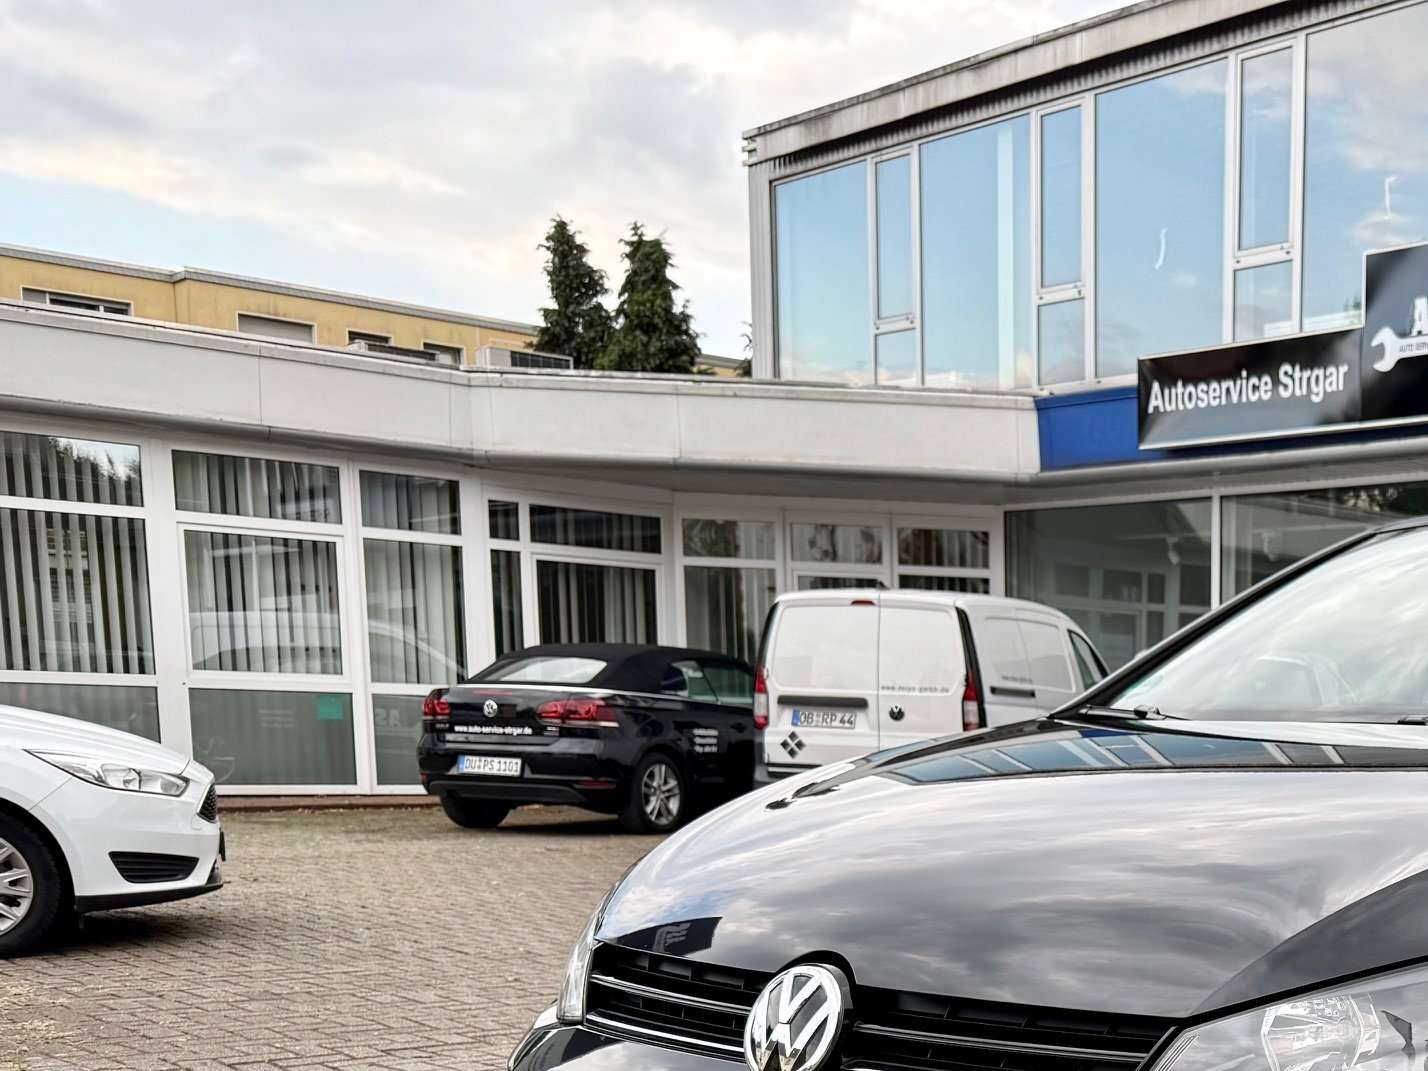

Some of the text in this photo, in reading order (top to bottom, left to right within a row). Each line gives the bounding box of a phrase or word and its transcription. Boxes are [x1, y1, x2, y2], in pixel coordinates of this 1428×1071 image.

[1147, 361, 1349, 415] Autoservice Strgar
[799, 711, 855, 727] OB RP 44
[464, 758, 477, 770] DU
[482, 759, 495, 771] PS
